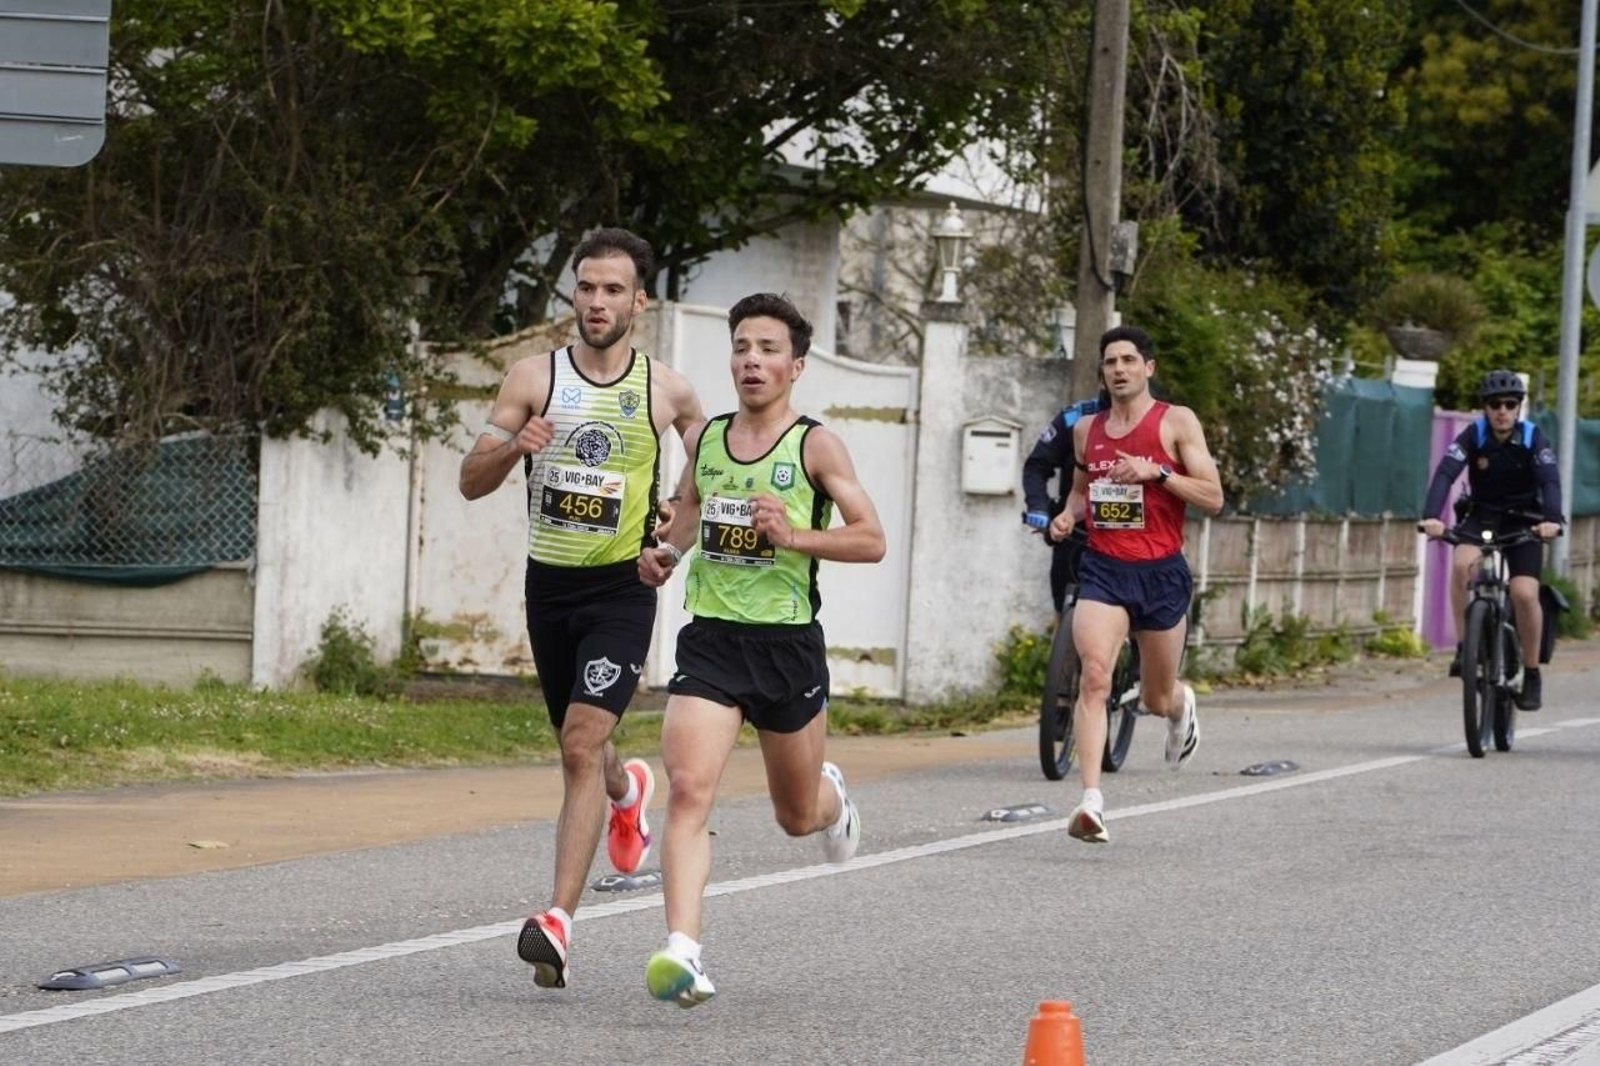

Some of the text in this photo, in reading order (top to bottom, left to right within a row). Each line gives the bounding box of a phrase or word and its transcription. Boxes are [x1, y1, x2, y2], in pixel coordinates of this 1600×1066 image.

[549, 470, 560, 483] 25
[560, 493, 603, 519] 456
[706, 503, 716, 516] 25
[1100, 503, 1130, 518] 652
[718, 525, 758, 550] 789
